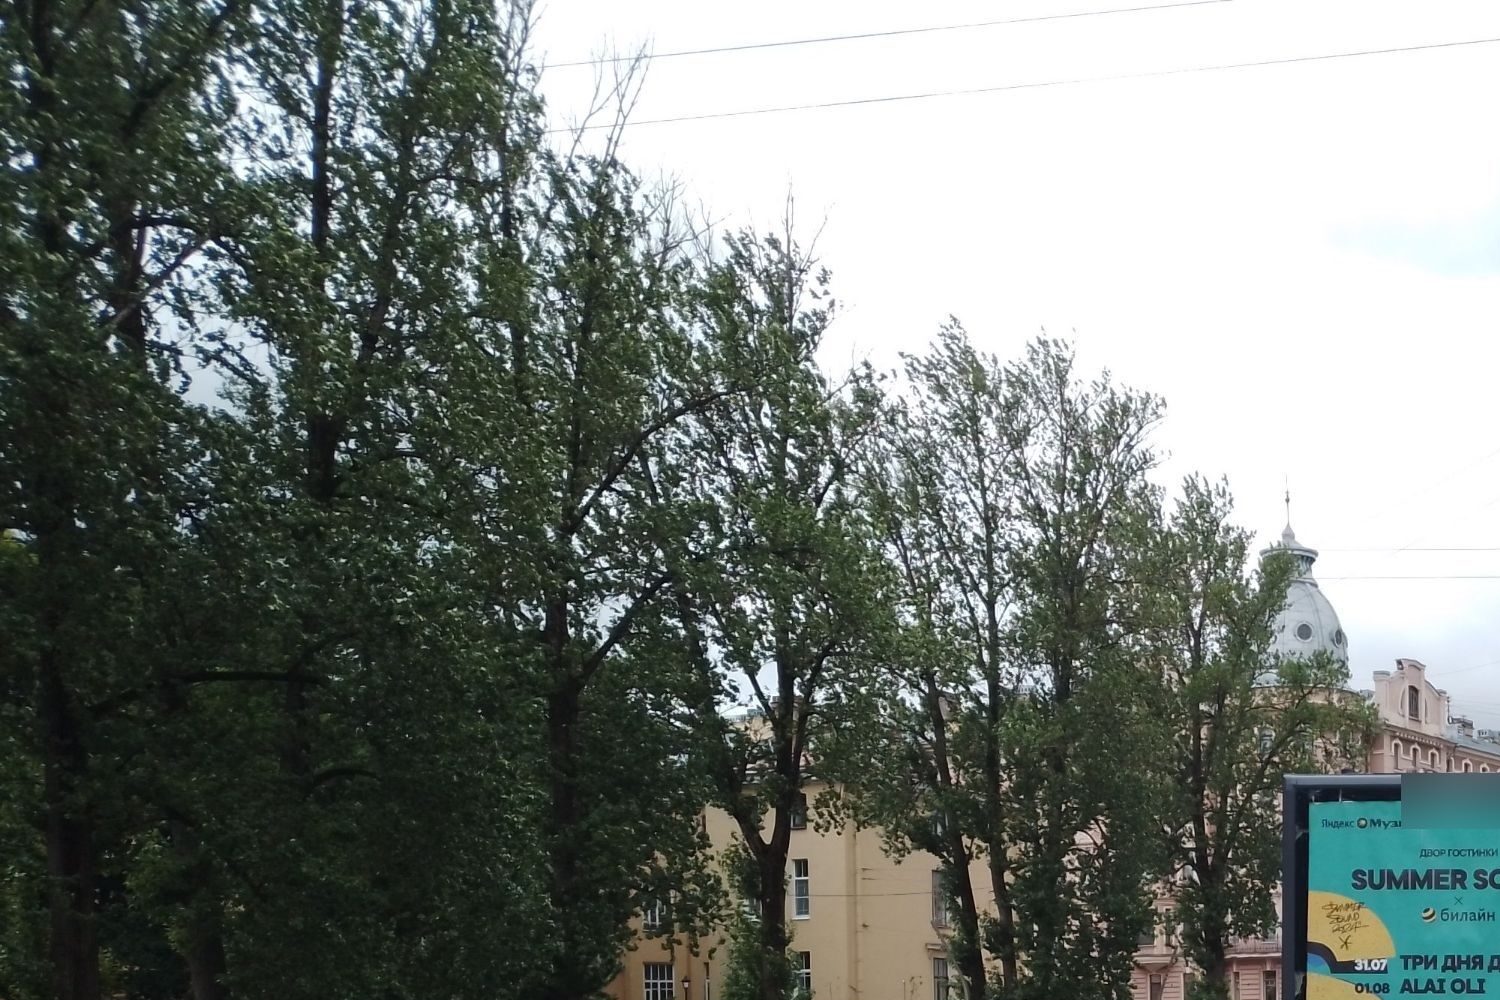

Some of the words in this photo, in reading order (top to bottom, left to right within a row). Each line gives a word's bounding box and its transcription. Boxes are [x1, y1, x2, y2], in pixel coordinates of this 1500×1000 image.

[1321, 818, 1355, 830] Яндекс
[1370, 818, 1402, 830] Муз
[1420, 848, 1446, 859] ДВОР
[1447, 848, 1499, 858] ГОСТИНКИ
[1351, 868, 1468, 891] SUMMER
[1440, 908, 1496, 922] билайн
[1354, 958, 1388, 972] 31.07
[1399, 954, 1438, 971] ТРИ
[1440, 954, 1484, 974] ДНЯ
[1354, 982, 1391, 995] 01.08
[1399, 978, 1446, 994] ALAI
[1450, 978, 1486, 995] OLI
